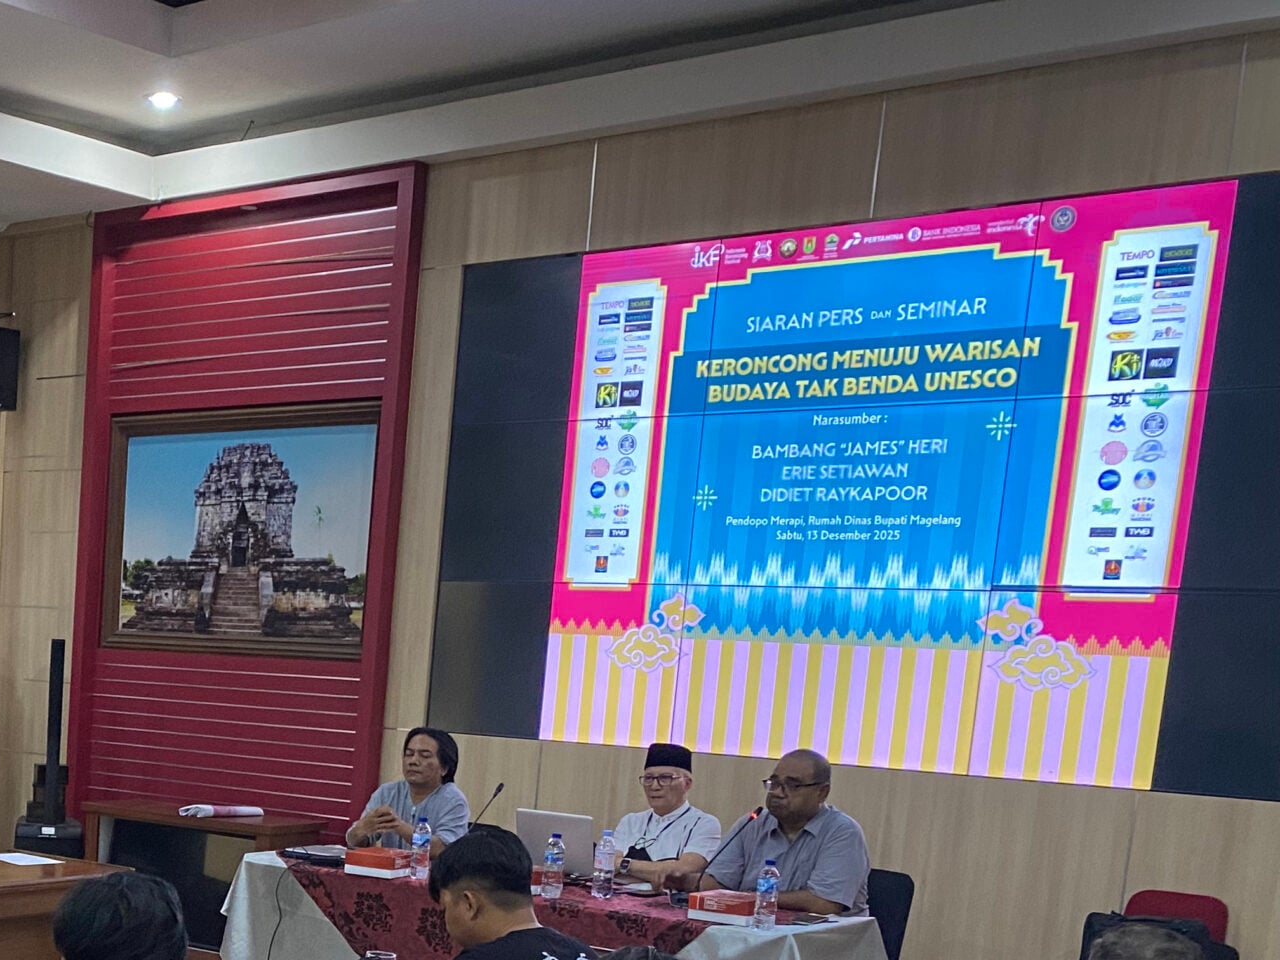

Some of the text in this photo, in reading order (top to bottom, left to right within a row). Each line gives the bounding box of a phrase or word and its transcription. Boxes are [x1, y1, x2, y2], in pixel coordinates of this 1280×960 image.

[1120, 249, 1155, 262] TEMPO
[746, 297, 988, 334] SIARAN PERS DAN SEMINAR
[696, 336, 1042, 378] KERONCONG MENUJU WARISAN
[707, 367, 1019, 403] BUDAYA TAK BENDA UNESCO
[812, 413, 881, 427] Narasumber
[751, 441, 836, 459] BAMBANG
[908, 438, 948, 455] HERI
[781, 462, 909, 480] ERIE SETIAWAN
[760, 485, 928, 503] DIDIET RAYKAPOOR
[725, 514, 962, 528] Pendopo Merapi, Rumah Dinas Bupati Magelang
[776, 530, 901, 542] Sabtu, 13 Desember 2025
